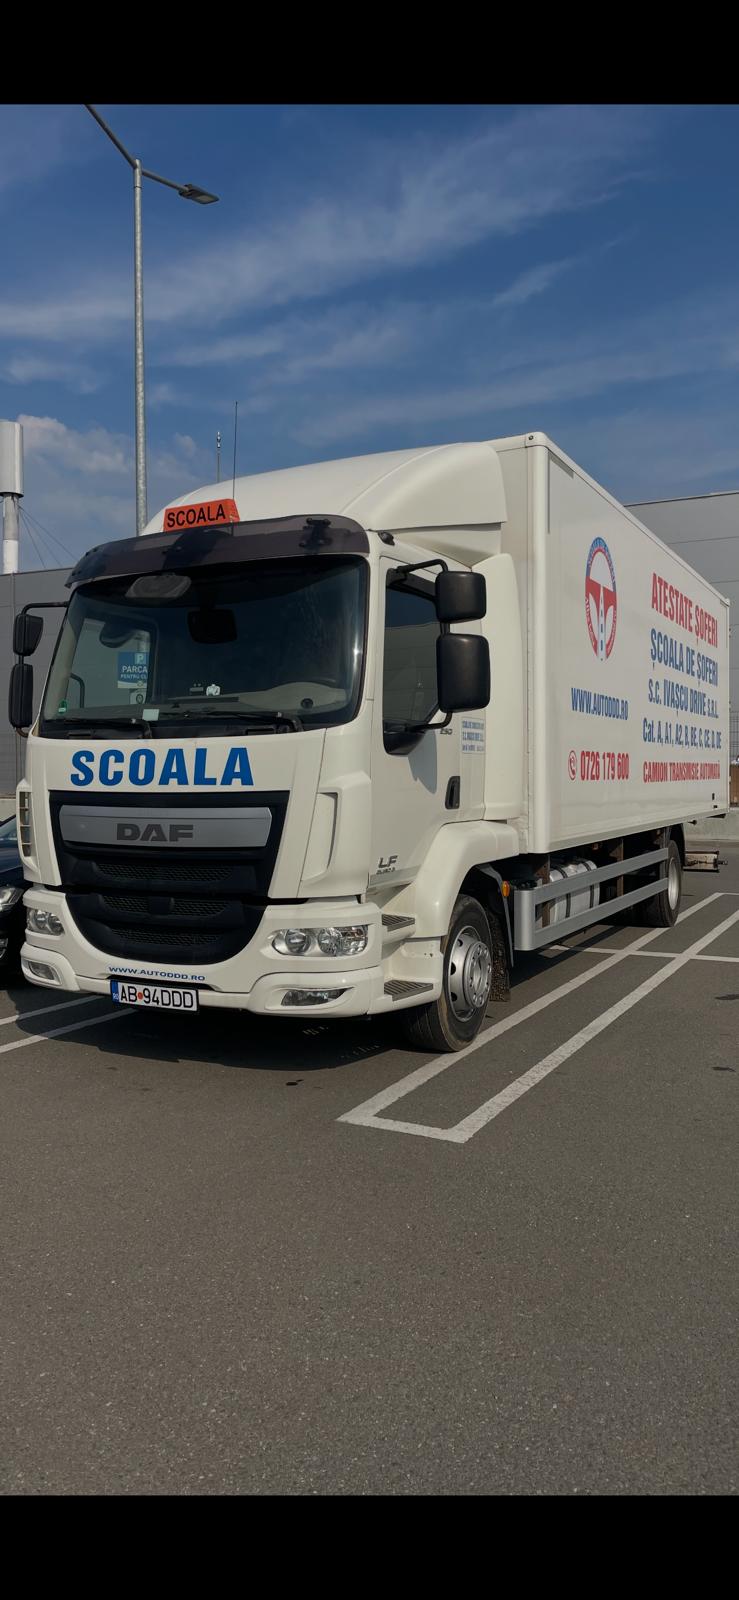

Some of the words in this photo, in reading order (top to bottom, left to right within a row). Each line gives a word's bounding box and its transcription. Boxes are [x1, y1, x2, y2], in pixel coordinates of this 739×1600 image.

[167, 504, 226, 528] SCOALA
[651, 573, 692, 632] ATESTATE
[686, 646, 695, 676] DE
[571, 688, 628, 720] WWW.AUTODDD.RO
[690, 689, 706, 716] DRIVE
[643, 718, 655, 742] Cat.
[70, 747, 254, 786] SCOALA
[580, 750, 600, 780] 0726
[602, 752, 615, 780] 179
[617, 752, 629, 780] 600
[643, 761, 667, 783] CAMION
[116, 823, 193, 842] DAF
[378, 855, 398, 868] LF
[109, 966, 205, 981] WWW.AUTODDD.RO
